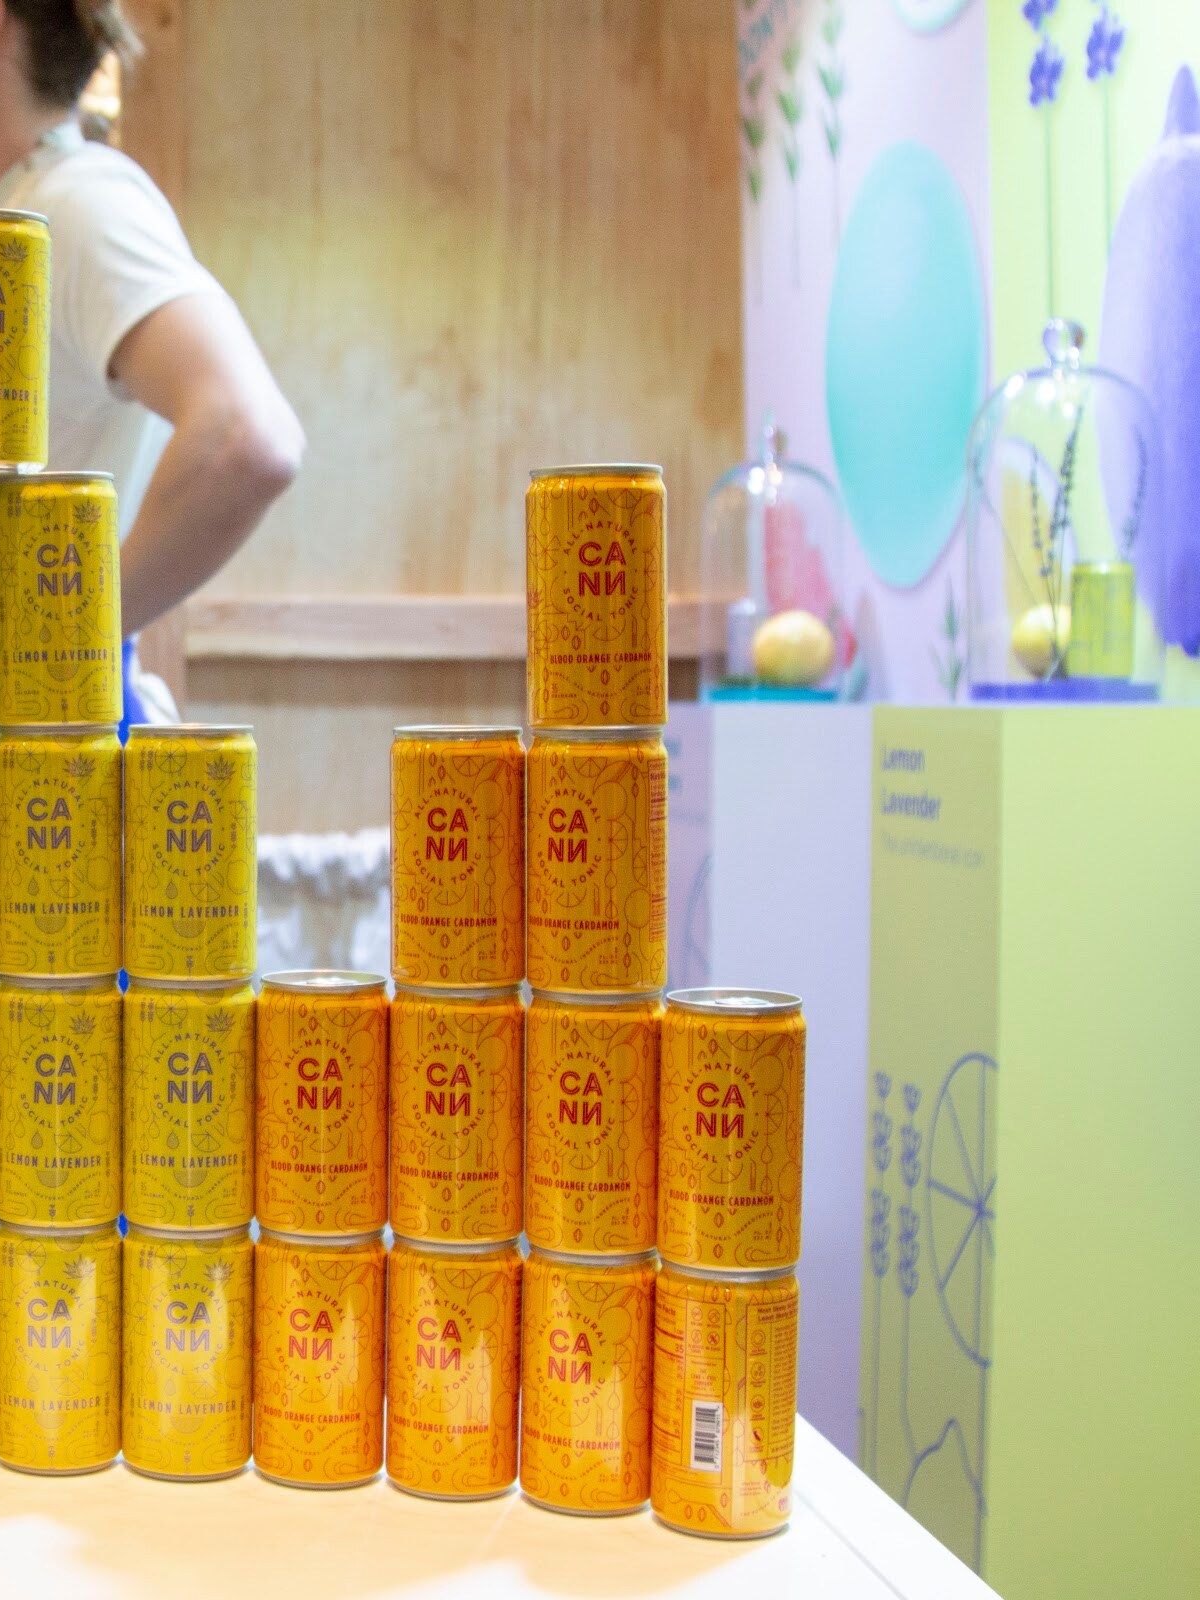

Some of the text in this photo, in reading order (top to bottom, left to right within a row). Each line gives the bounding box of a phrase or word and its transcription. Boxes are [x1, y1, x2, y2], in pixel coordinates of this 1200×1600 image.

[37, 544, 82, 567] CA
[579, 541, 626, 566] CA
[12, 649, 108, 662] LEMON LAVENDER
[576, 653, 611, 663] ORANGE
[27, 798, 71, 821] CA
[167, 801, 212, 824] CA
[428, 807, 469, 833] CA
[549, 808, 588, 833] CA
[4, 902, 100, 914] LEMON LAVENDER
[139, 906, 239, 918] LEMON LAVENDER
[421, 916, 450, 926] ORANGE
[545, 919, 571, 929] ORANGE
[35, 1054, 77, 1077] CA
[168, 1052, 212, 1075] CA
[298, 1058, 343, 1082] CA
[427, 1063, 471, 1087] CA
[560, 1071, 602, 1096] CA
[697, 1083, 744, 1108] CA
[5, 1153, 101, 1168] LEMON LAVENDER
[140, 1155, 238, 1168] LEMON LAVENDER
[295, 1163, 326, 1173] ORANGE
[421, 1169, 453, 1180] ORANGE
[555, 1179, 585, 1191] ORANGE
[692, 1194, 725, 1205] ORANGE
[28, 1298, 71, 1322] CA
[167, 1301, 211, 1325] CA
[290, 1309, 333, 1332] CA
[418, 1317, 461, 1342] CA
[549, 1329, 592, 1356] CA
[3, 1396, 100, 1410] LEMON LAVENDER
[137, 1400, 236, 1415] LEMON LAVENDER
[285, 1411, 314, 1423] ORANGE
[413, 1422, 443, 1433] ORANGE
[543, 1433, 572, 1446] ORANGE
